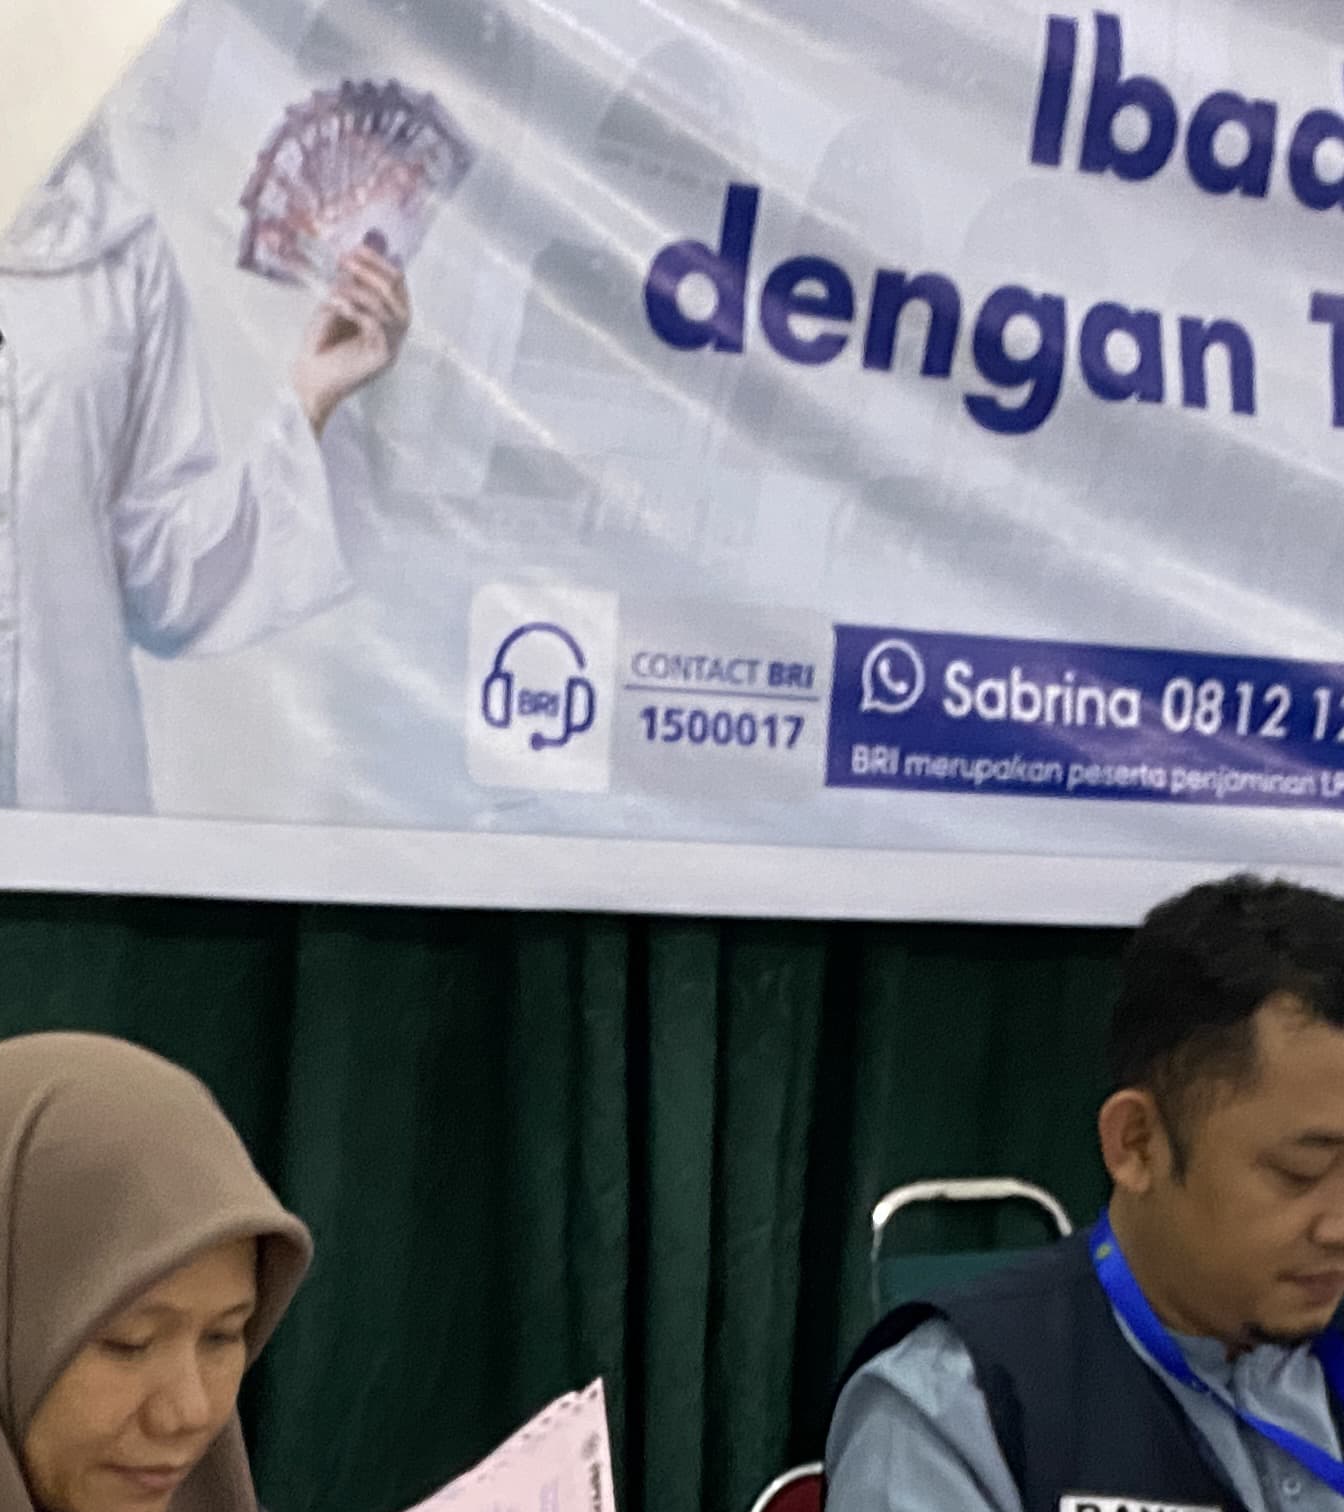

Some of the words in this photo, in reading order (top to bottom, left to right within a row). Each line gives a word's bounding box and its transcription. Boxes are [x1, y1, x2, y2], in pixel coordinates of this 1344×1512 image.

[644, 182, 1256, 435] dengan
[630, 650, 758, 685] CONTACT
[767, 662, 815, 690] BRI
[516, 689, 561, 718] BRI
[942, 659, 1142, 729] Sabrina
[1160, 676, 1293, 738] 0812
[641, 706, 805, 749] 1500017
[851, 744, 900, 774] BRI
[904, 753, 1063, 785] merupakan
[1066, 762, 1167, 791] peserta
